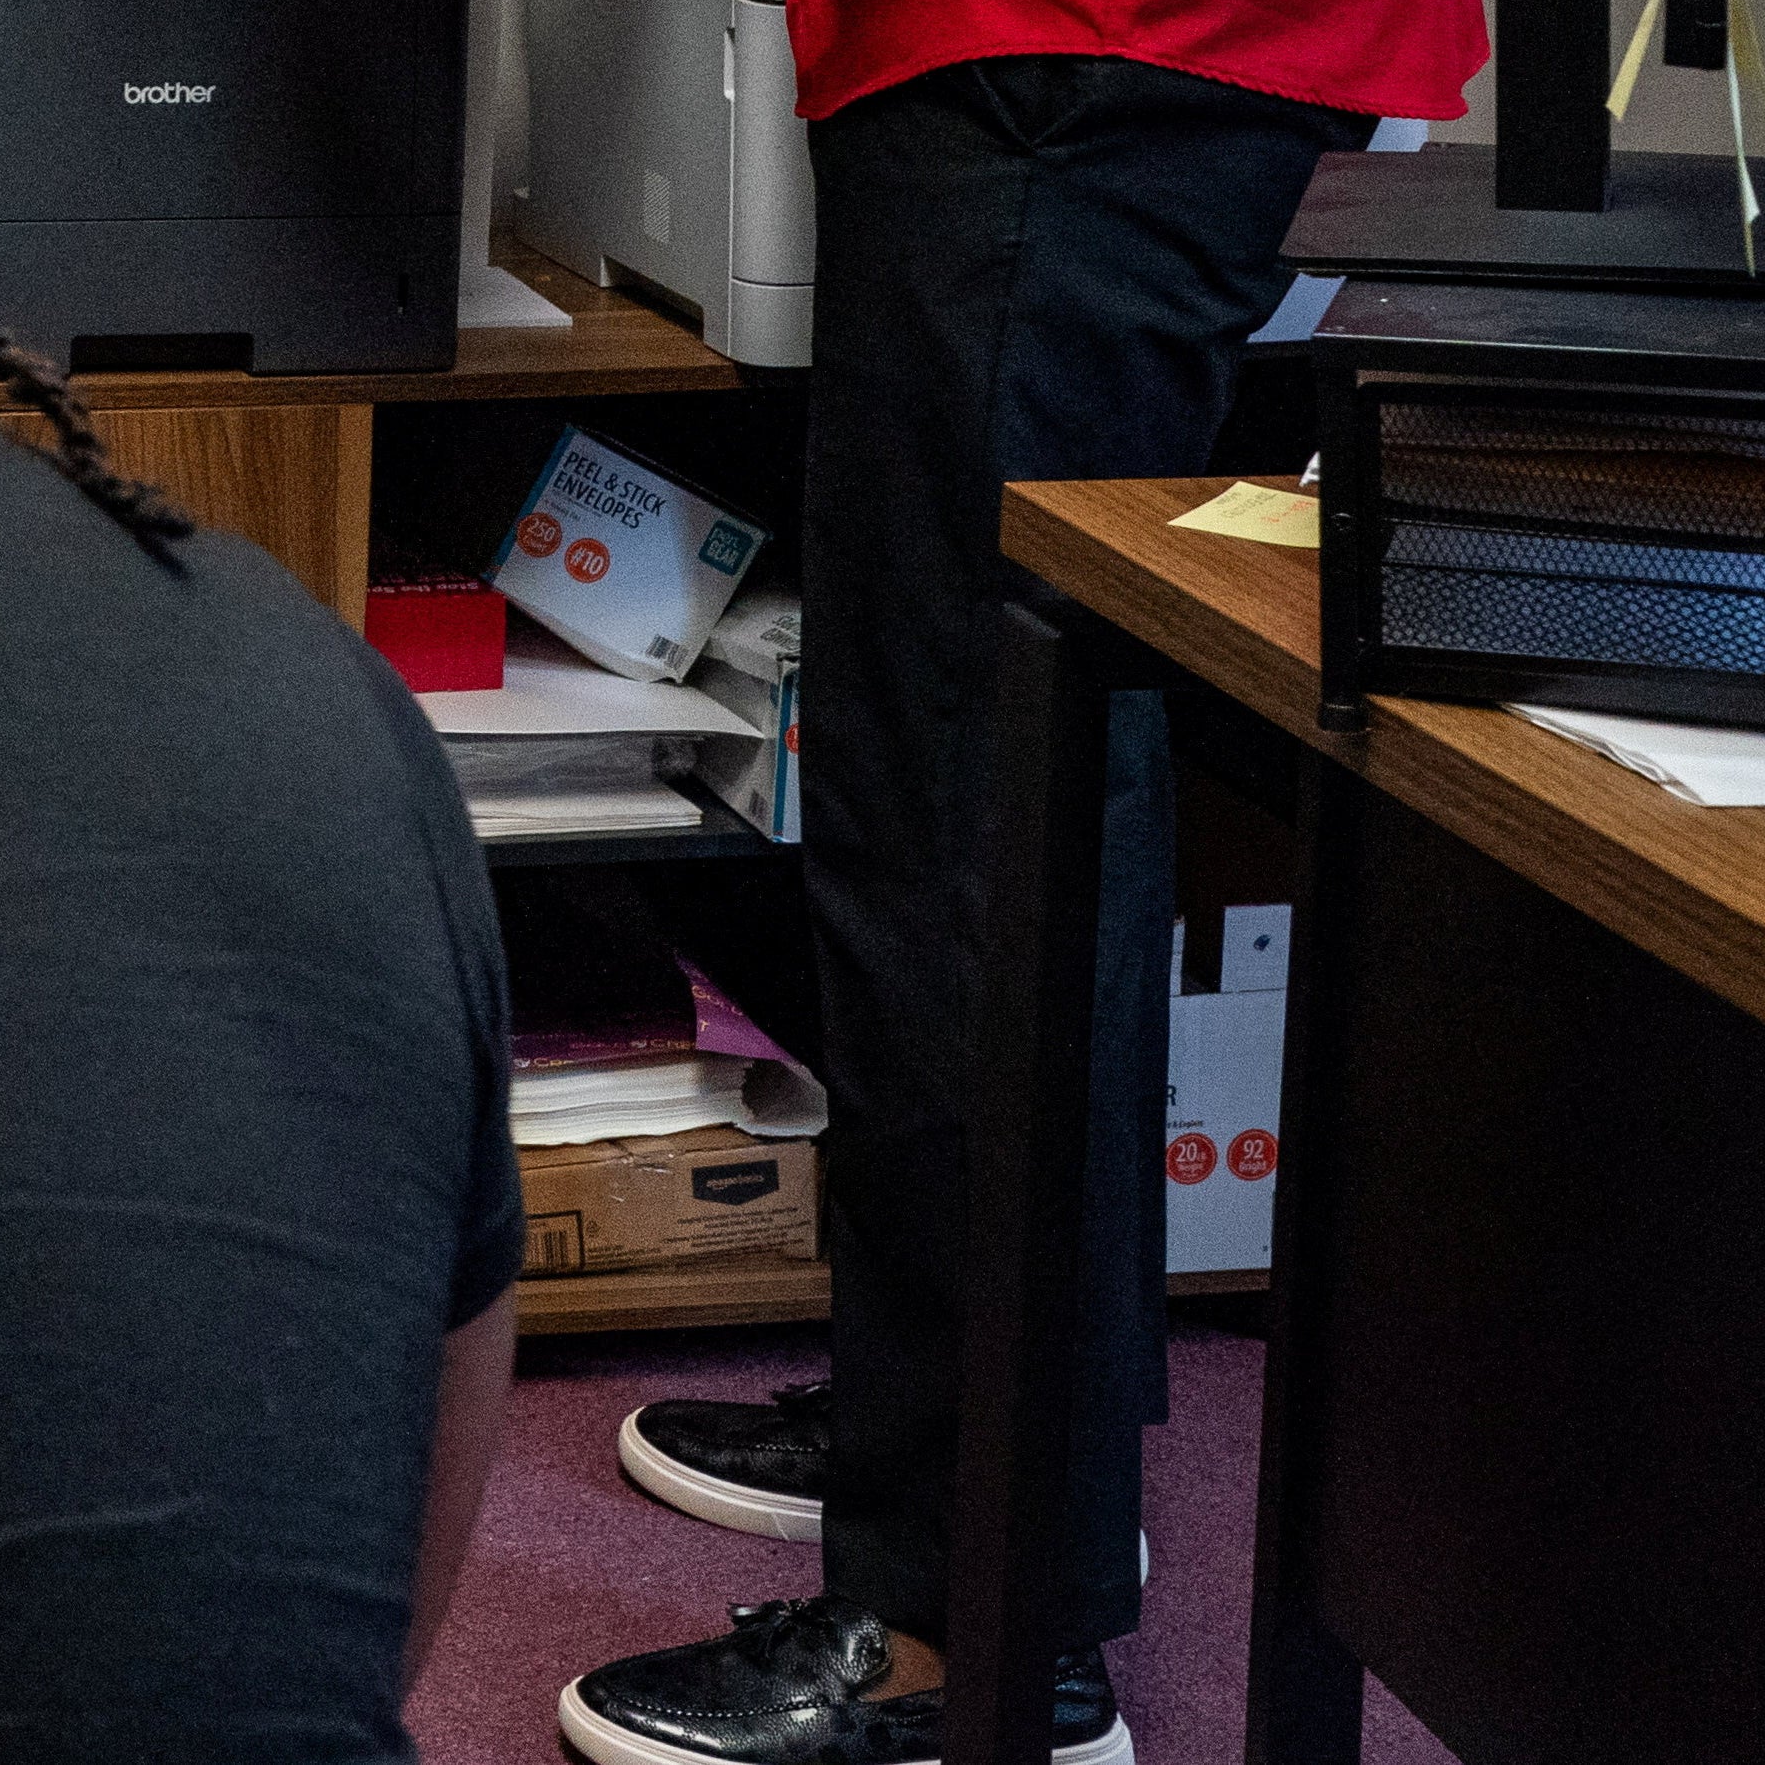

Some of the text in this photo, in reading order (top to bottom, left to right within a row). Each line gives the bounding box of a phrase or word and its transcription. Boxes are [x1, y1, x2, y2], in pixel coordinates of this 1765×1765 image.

[124, 81, 216, 104] brother
[562, 451, 604, 485] PEEL
[604, 472, 618, 493] &
[618, 480, 667, 517] STICK
[553, 471, 645, 530] ENVELOPES
[526, 519, 557, 543] 250
[570, 546, 605, 576] #10
[1176, 1142, 1198, 1163] 20
[1243, 1139, 1264, 1160] 92
[1238, 1160, 1268, 1174] Bright
